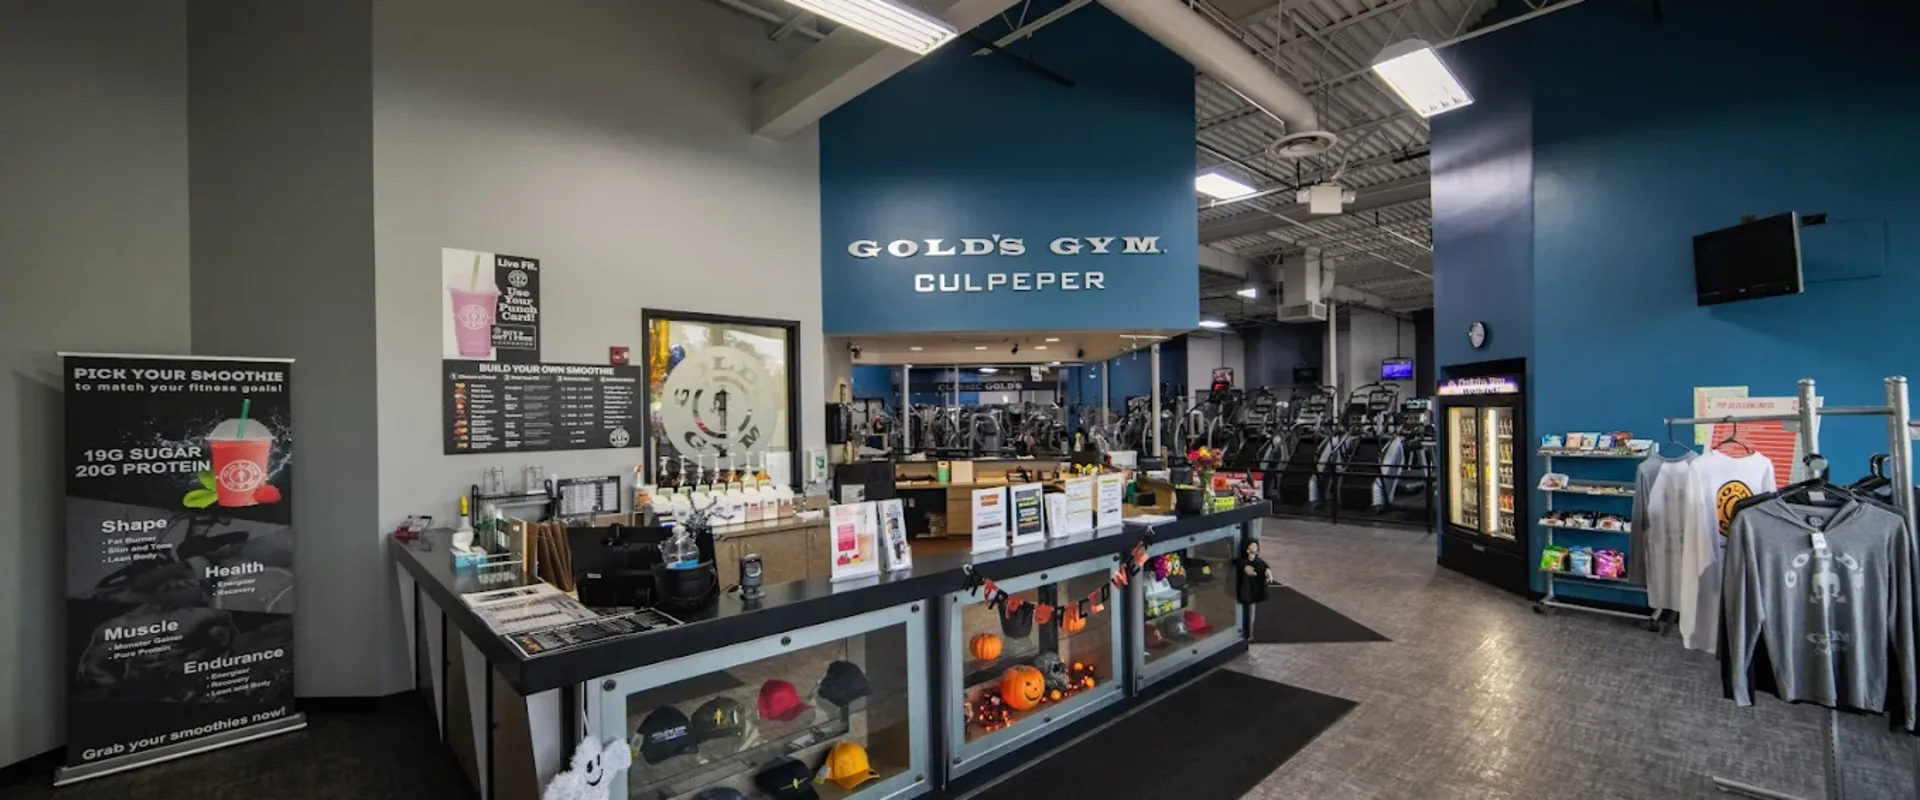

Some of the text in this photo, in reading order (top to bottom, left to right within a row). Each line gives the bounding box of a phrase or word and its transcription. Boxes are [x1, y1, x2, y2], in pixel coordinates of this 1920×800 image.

[847, 233, 1026, 258] GOLD'S
[498, 258, 538, 271] Live Fit.
[914, 271, 1106, 293] CULPEPER
[507, 287, 530, 297] Use
[504, 295, 534, 306] Your
[499, 303, 538, 314] Punch
[501, 312, 535, 322] Card!
[74, 368, 283, 382] PICK YOUR SMOOTHIE
[479, 363, 615, 376] BUILD YOUR OWN SMOOTHIE
[74, 383, 283, 393] to match your fitness goals!
[985, 381, 1023, 391] GOLD'S
[84, 446, 202, 462] 19G SUGAR
[75, 464, 117, 478] 20G
[122, 460, 211, 476] PROTEIN
[102, 518, 168, 534] Shape
[108, 536, 157, 546] Fat Burner
[108, 543, 173, 555] Slim and Tone
[108, 553, 158, 564] Lean Body
[205, 561, 265, 578] Health
[217, 578, 256, 588] Energizer
[217, 586, 256, 596] Recovery
[104, 620, 179, 641] Muscle
[113, 634, 184, 651] Monster Gainer
[114, 644, 172, 660] Pure Protein
[184, 648, 285, 674] Endurance
[211, 668, 251, 680] Energizer
[211, 676, 250, 688] Recovery
[211, 679, 272, 697] Lean and Body
[82, 706, 287, 760] Grab your smoothies now!
